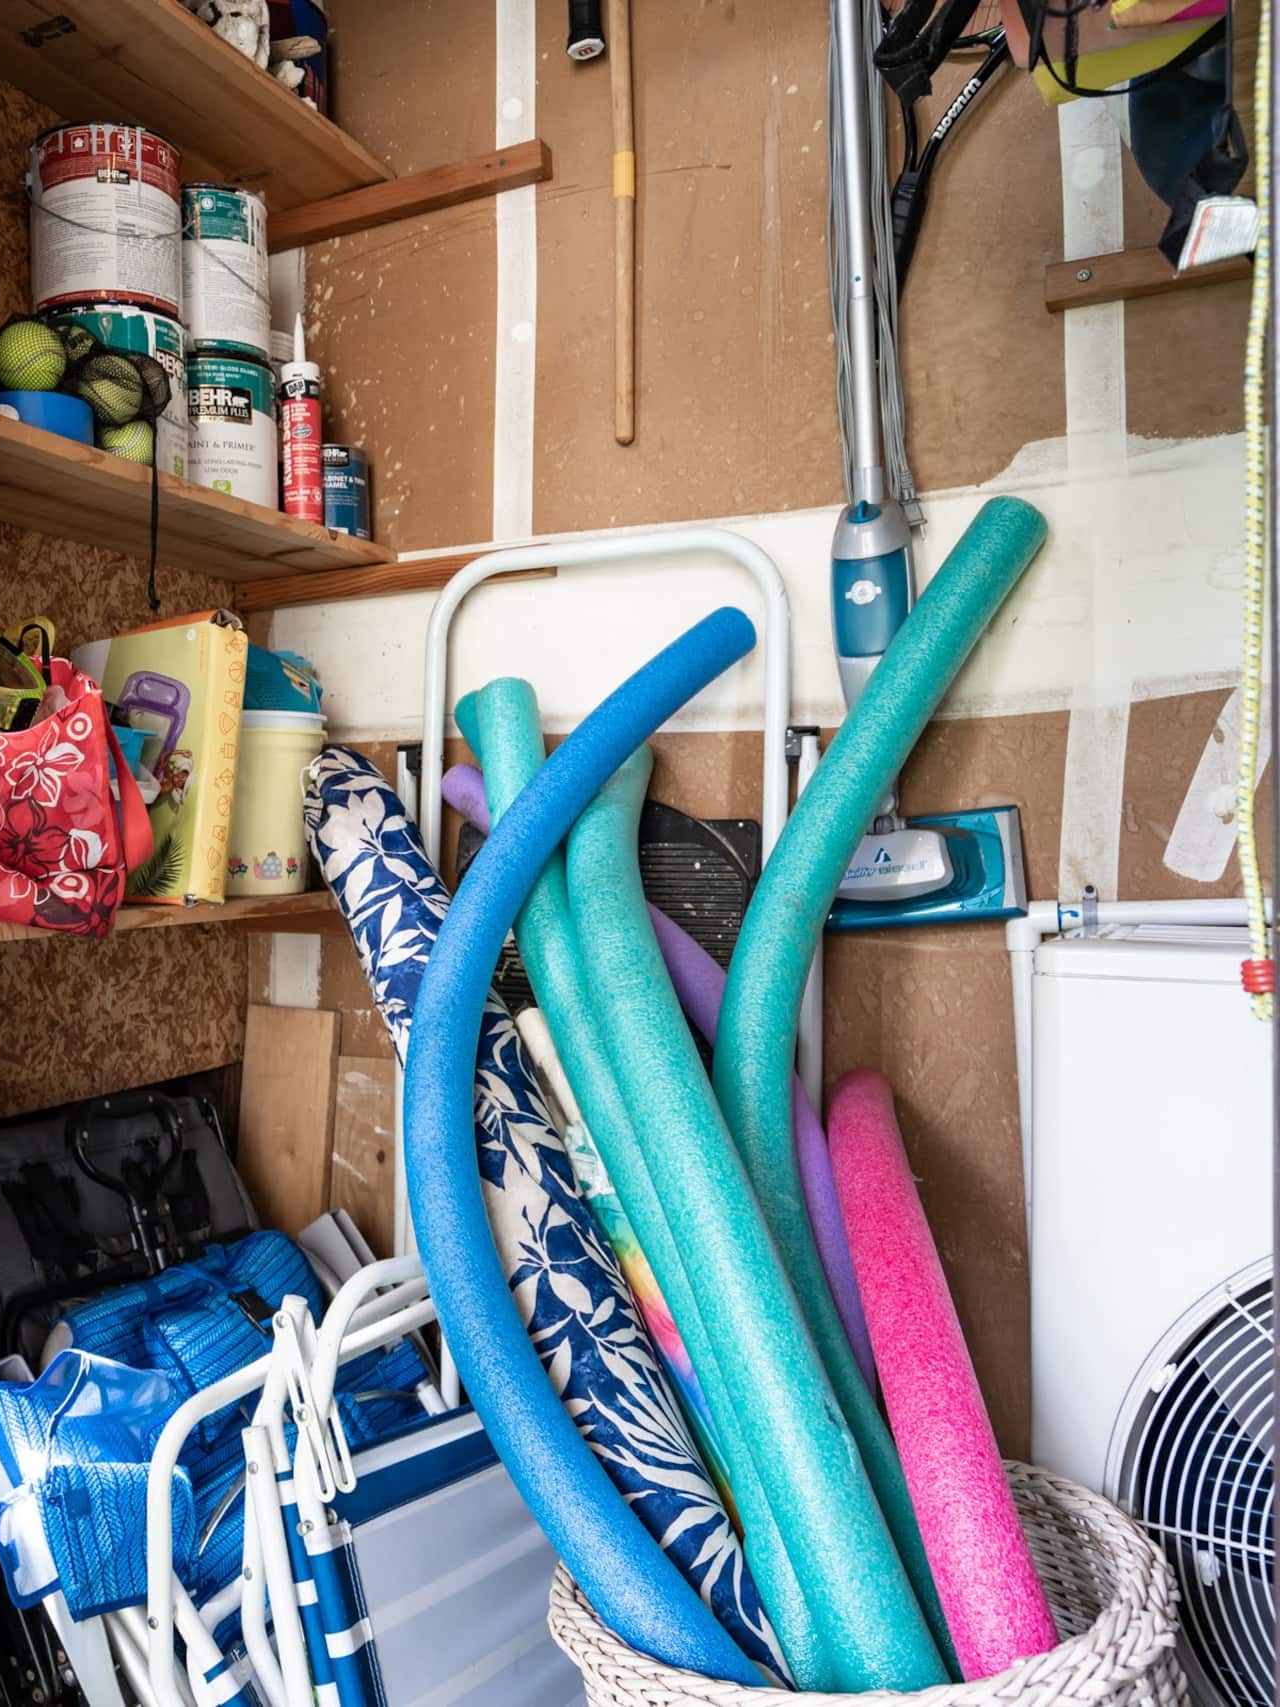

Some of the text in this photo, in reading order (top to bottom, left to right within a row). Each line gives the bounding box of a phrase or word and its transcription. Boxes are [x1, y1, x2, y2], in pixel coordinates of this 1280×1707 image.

[931, 78, 982, 140] Wilson
[287, 380, 305, 394] DAP
[188, 387, 233, 406] BEHR
[189, 405, 229, 417] PREMIUM
[230, 406, 250, 418] PLUS
[187, 439, 209, 449] AINT
